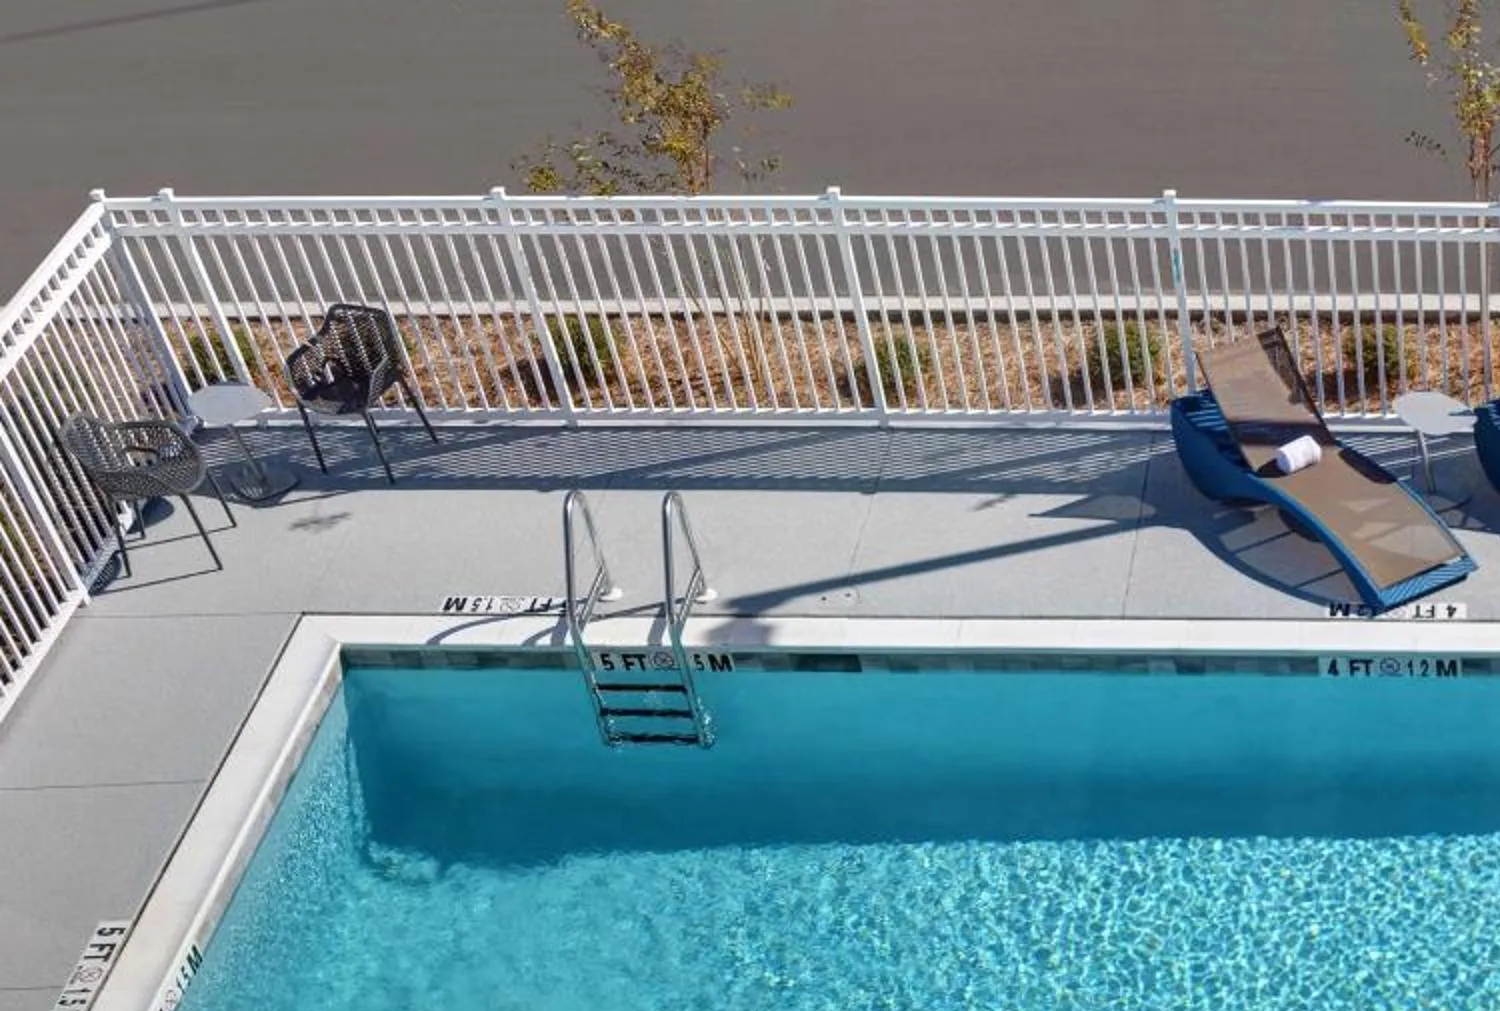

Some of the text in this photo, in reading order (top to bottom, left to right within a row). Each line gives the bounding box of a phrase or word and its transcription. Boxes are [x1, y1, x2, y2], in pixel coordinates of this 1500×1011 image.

[443, 597, 467, 611] M
[1330, 604, 1349, 616] M
[1446, 605, 1457, 617] 4
[1413, 605, 1435, 618] FT
[600, 653, 615, 671] 5
[621, 654, 646, 671] FT
[708, 654, 733, 672] M
[1327, 659, 1339, 676] 4
[1349, 659, 1373, 676] FT
[1436, 659, 1457, 676] M
[97, 927, 126, 936] 5
[84, 943, 116, 962] FT
[186, 944, 204, 974] M
